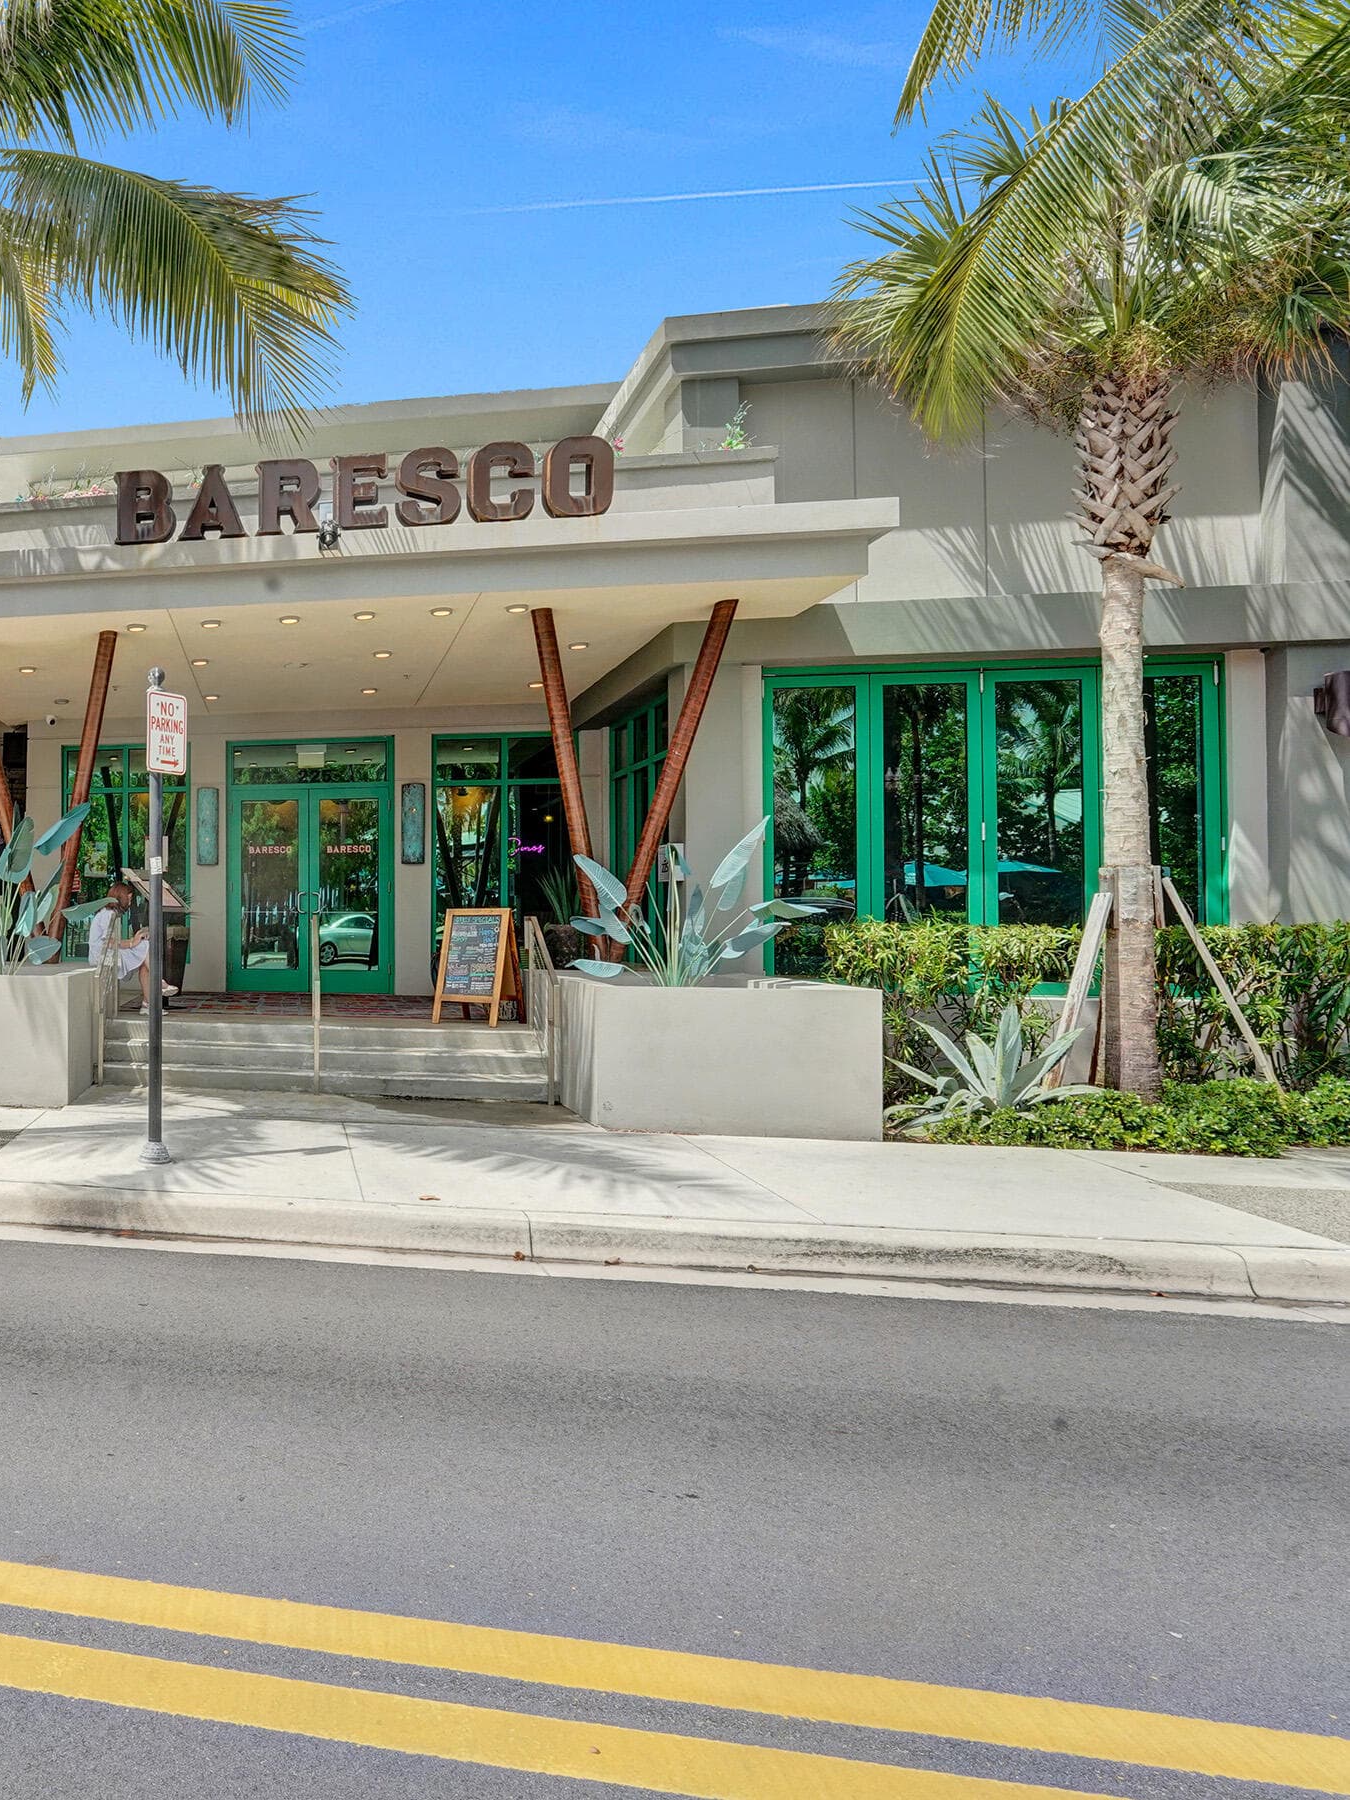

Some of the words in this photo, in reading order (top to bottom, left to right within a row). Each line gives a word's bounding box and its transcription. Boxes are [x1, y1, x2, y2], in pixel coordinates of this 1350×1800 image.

[114, 435, 615, 545] BARESCO
[160, 701, 175, 717] NO
[151, 716, 183, 734] PARKING
[159, 734, 175, 745] ANY
[158, 745, 176, 757] TIME
[249, 846, 293, 854] BARESCO
[327, 845, 372, 854] BARESCO
